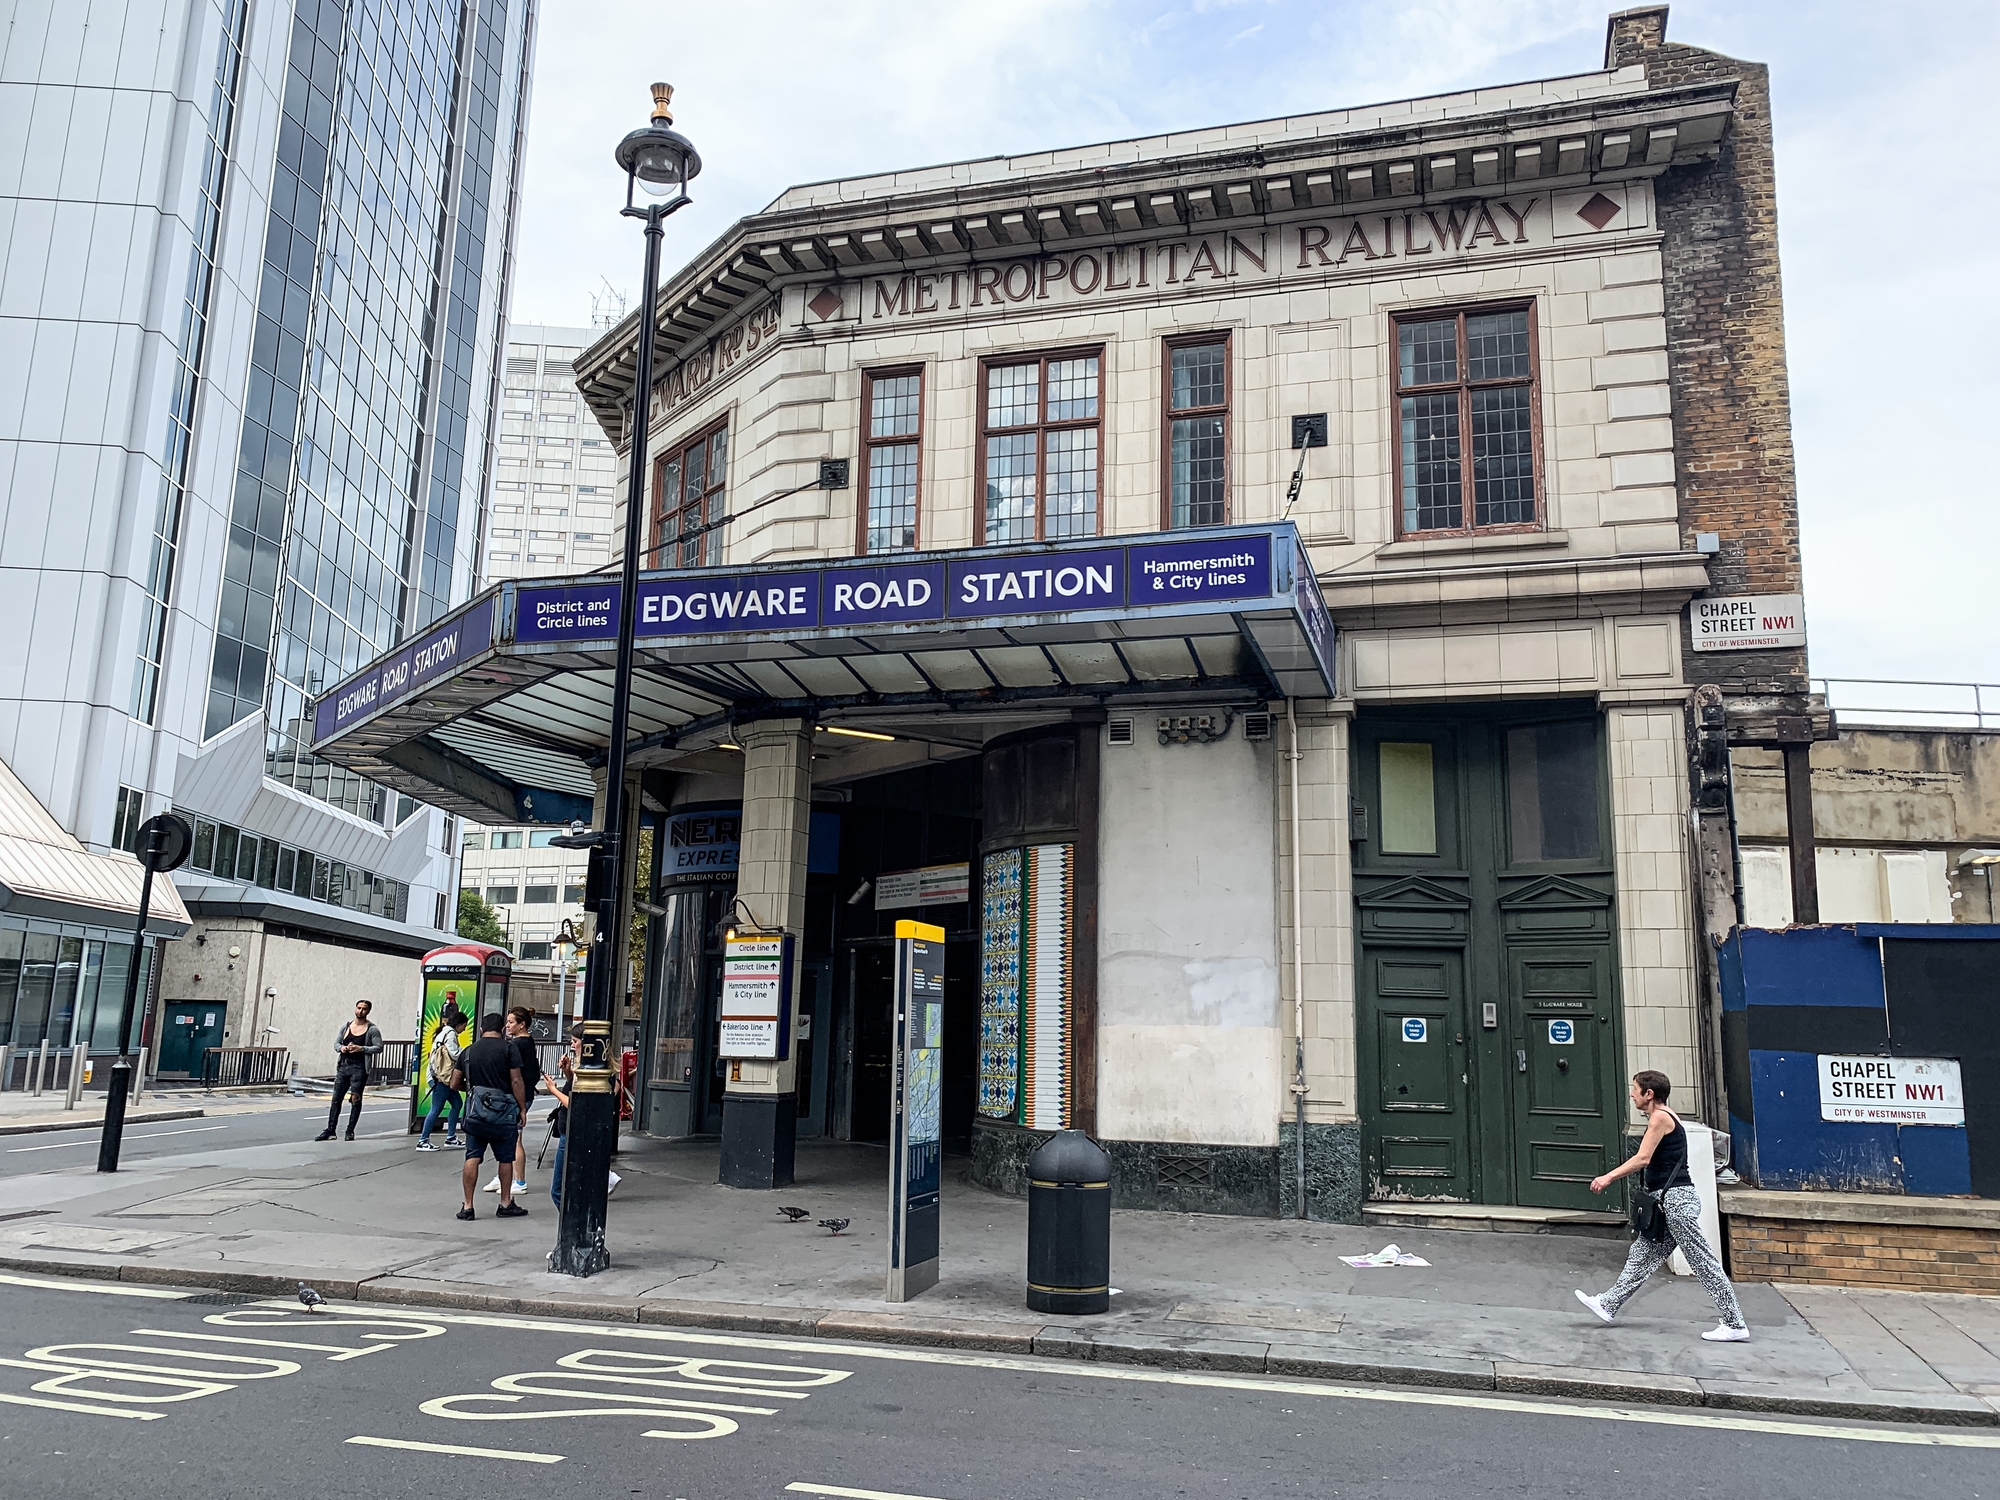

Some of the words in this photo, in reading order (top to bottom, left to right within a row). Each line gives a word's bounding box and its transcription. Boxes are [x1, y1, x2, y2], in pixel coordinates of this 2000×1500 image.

[872, 231, 1270, 318] METROPOLITAN
[1296, 198, 1540, 268] RAILWAY
[1144, 553, 1255, 575] Hammersmith
[1152, 577, 1165, 590] &
[1169, 574, 1203, 590] City
[1208, 572, 1246, 586] lines
[642, 587, 807, 623] EDGWARE
[834, 578, 932, 612] ROAD
[961, 564, 1113, 604] STATION
[536, 601, 584, 614] District
[587, 598, 610, 611] and
[1700, 602, 1756, 617] CHAPEL
[537, 615, 574, 629] Circle
[577, 614, 608, 627] lines
[1701, 617, 1756, 633] STREET
[1763, 616, 1794, 630] NW1
[1730, 638, 1779, 646] WESTMINSTER
[337, 678, 378, 721] EDGWARE
[381, 661, 408, 695] ROAD
[413, 631, 458, 676] STATION
[687, 873, 714, 881] ITALIAN
[596, 932, 604, 943] 4
[739, 944, 755, 952] Circle
[757, 944, 770, 952] line
[734, 963, 754, 971] District
[756, 963, 769, 971] line
[728, 982, 768, 990] Hammersmith
[740, 990, 753, 1000] City
[727, 1022, 750, 1031] Bakerloo
[750, 1023, 764, 1031] line
[1830, 1062, 1896, 1079] CHAPEL
[1832, 1081, 1896, 1099] STREET
[1905, 1084, 1944, 1100] NW1
[1834, 1108, 1852, 1117] CITY
[1855, 1109, 1865, 1117] OF
[1868, 1110, 1927, 1119] WESTMINSTER
[0, 1310, 447, 1404] STOP
[418, 1348, 855, 1440] BUS
